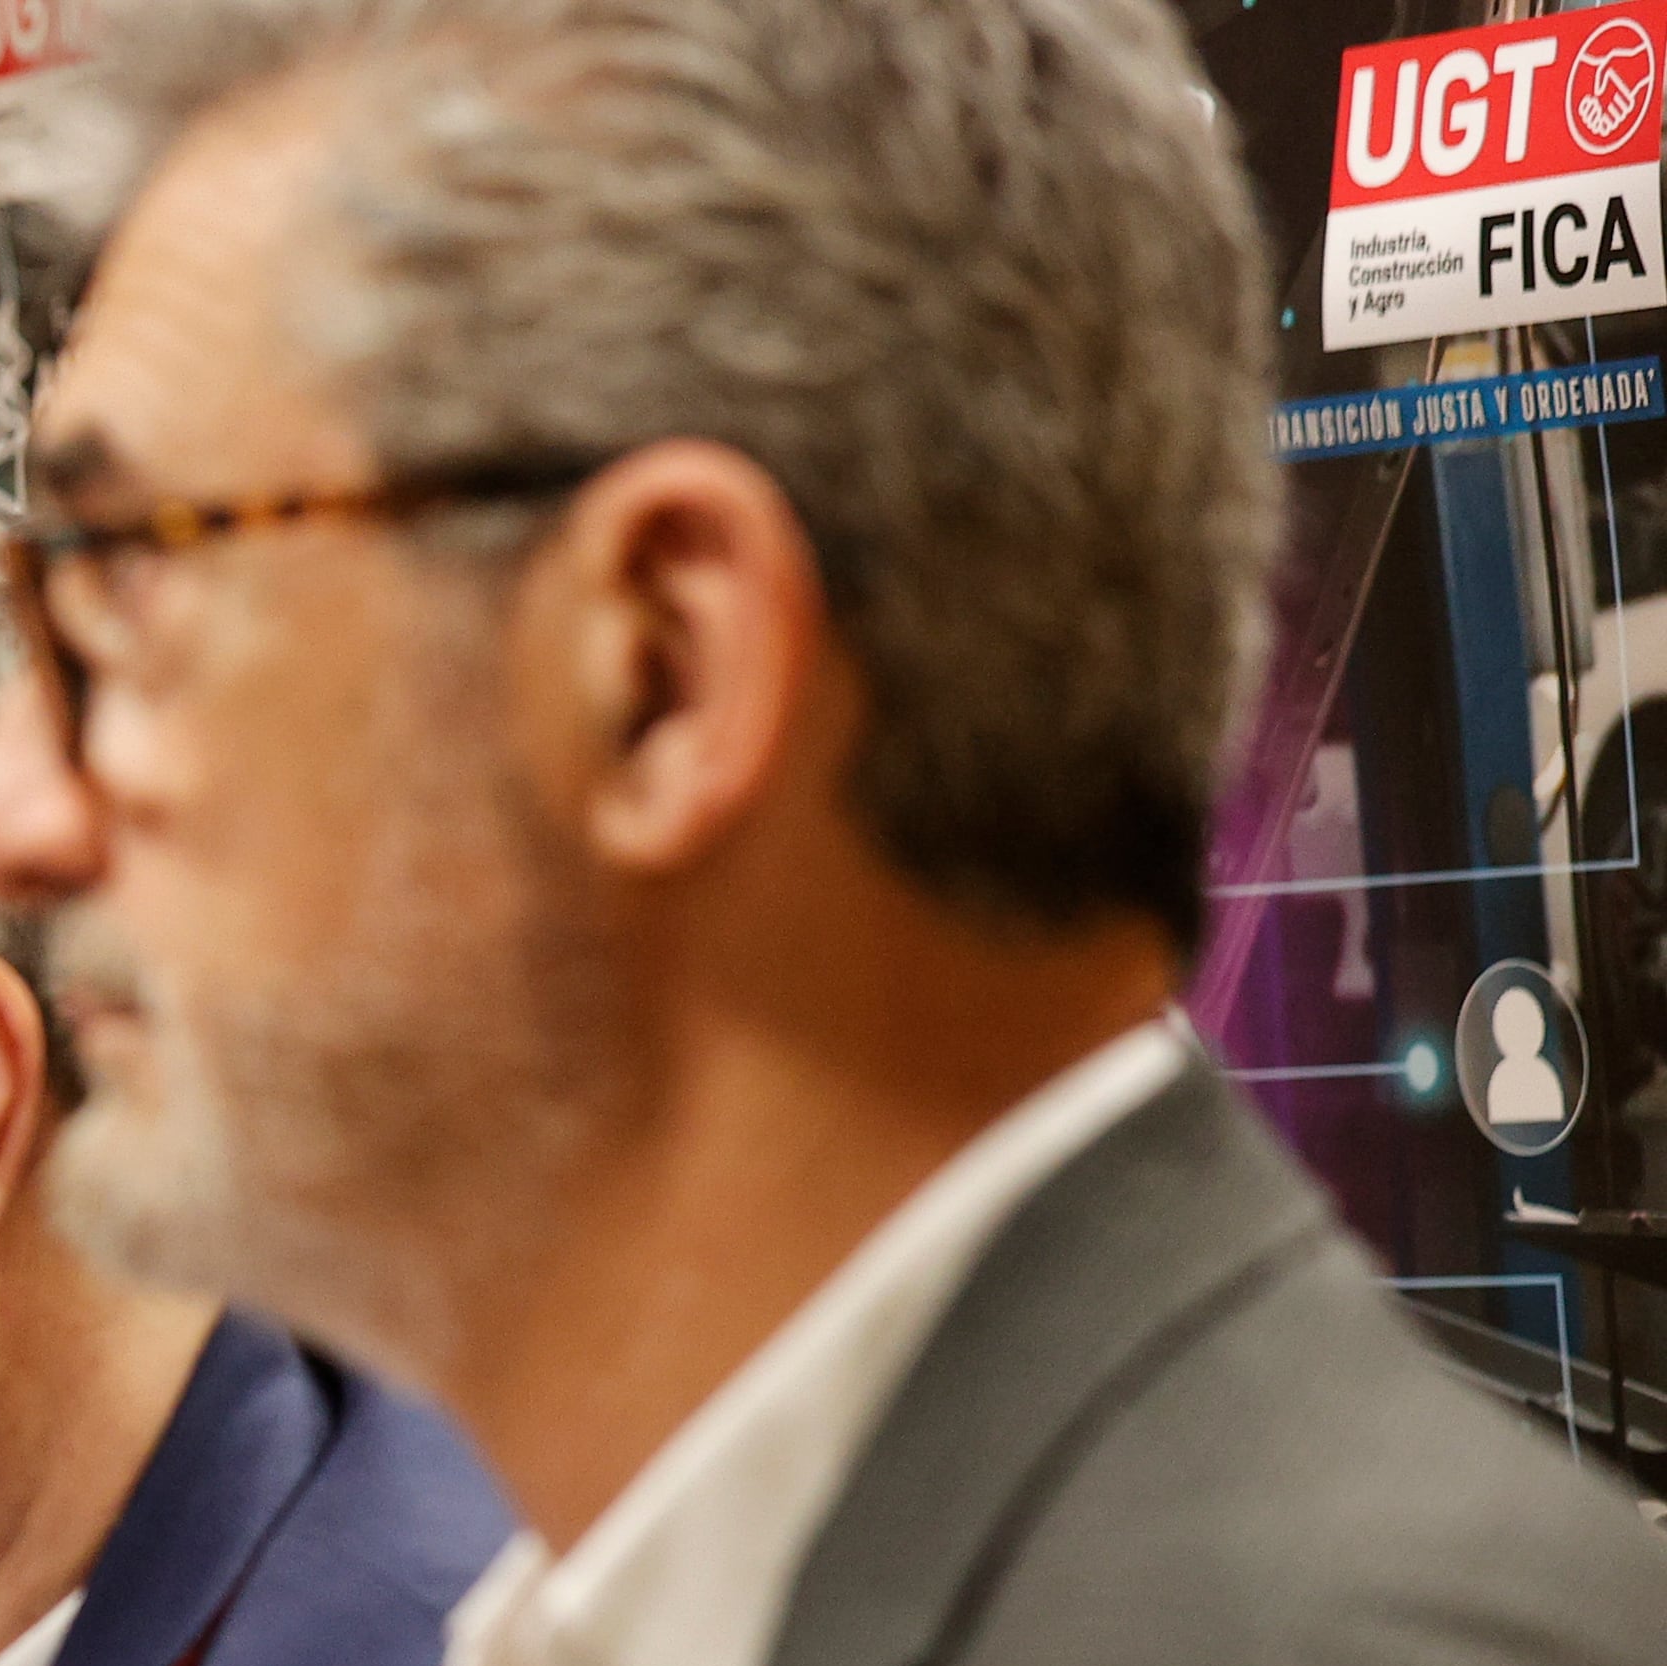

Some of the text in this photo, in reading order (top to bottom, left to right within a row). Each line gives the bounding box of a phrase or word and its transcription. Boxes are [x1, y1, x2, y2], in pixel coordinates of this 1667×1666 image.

[1346, 36, 1558, 189] UGT
[1349, 247, 1464, 287] Construcción
[1350, 229, 1430, 259] Industria,
[1479, 195, 1647, 299] FICA
[1349, 289, 1405, 322] y Agro
[1413, 388, 1486, 438] JUSTA
[1493, 384, 1510, 425] Y
